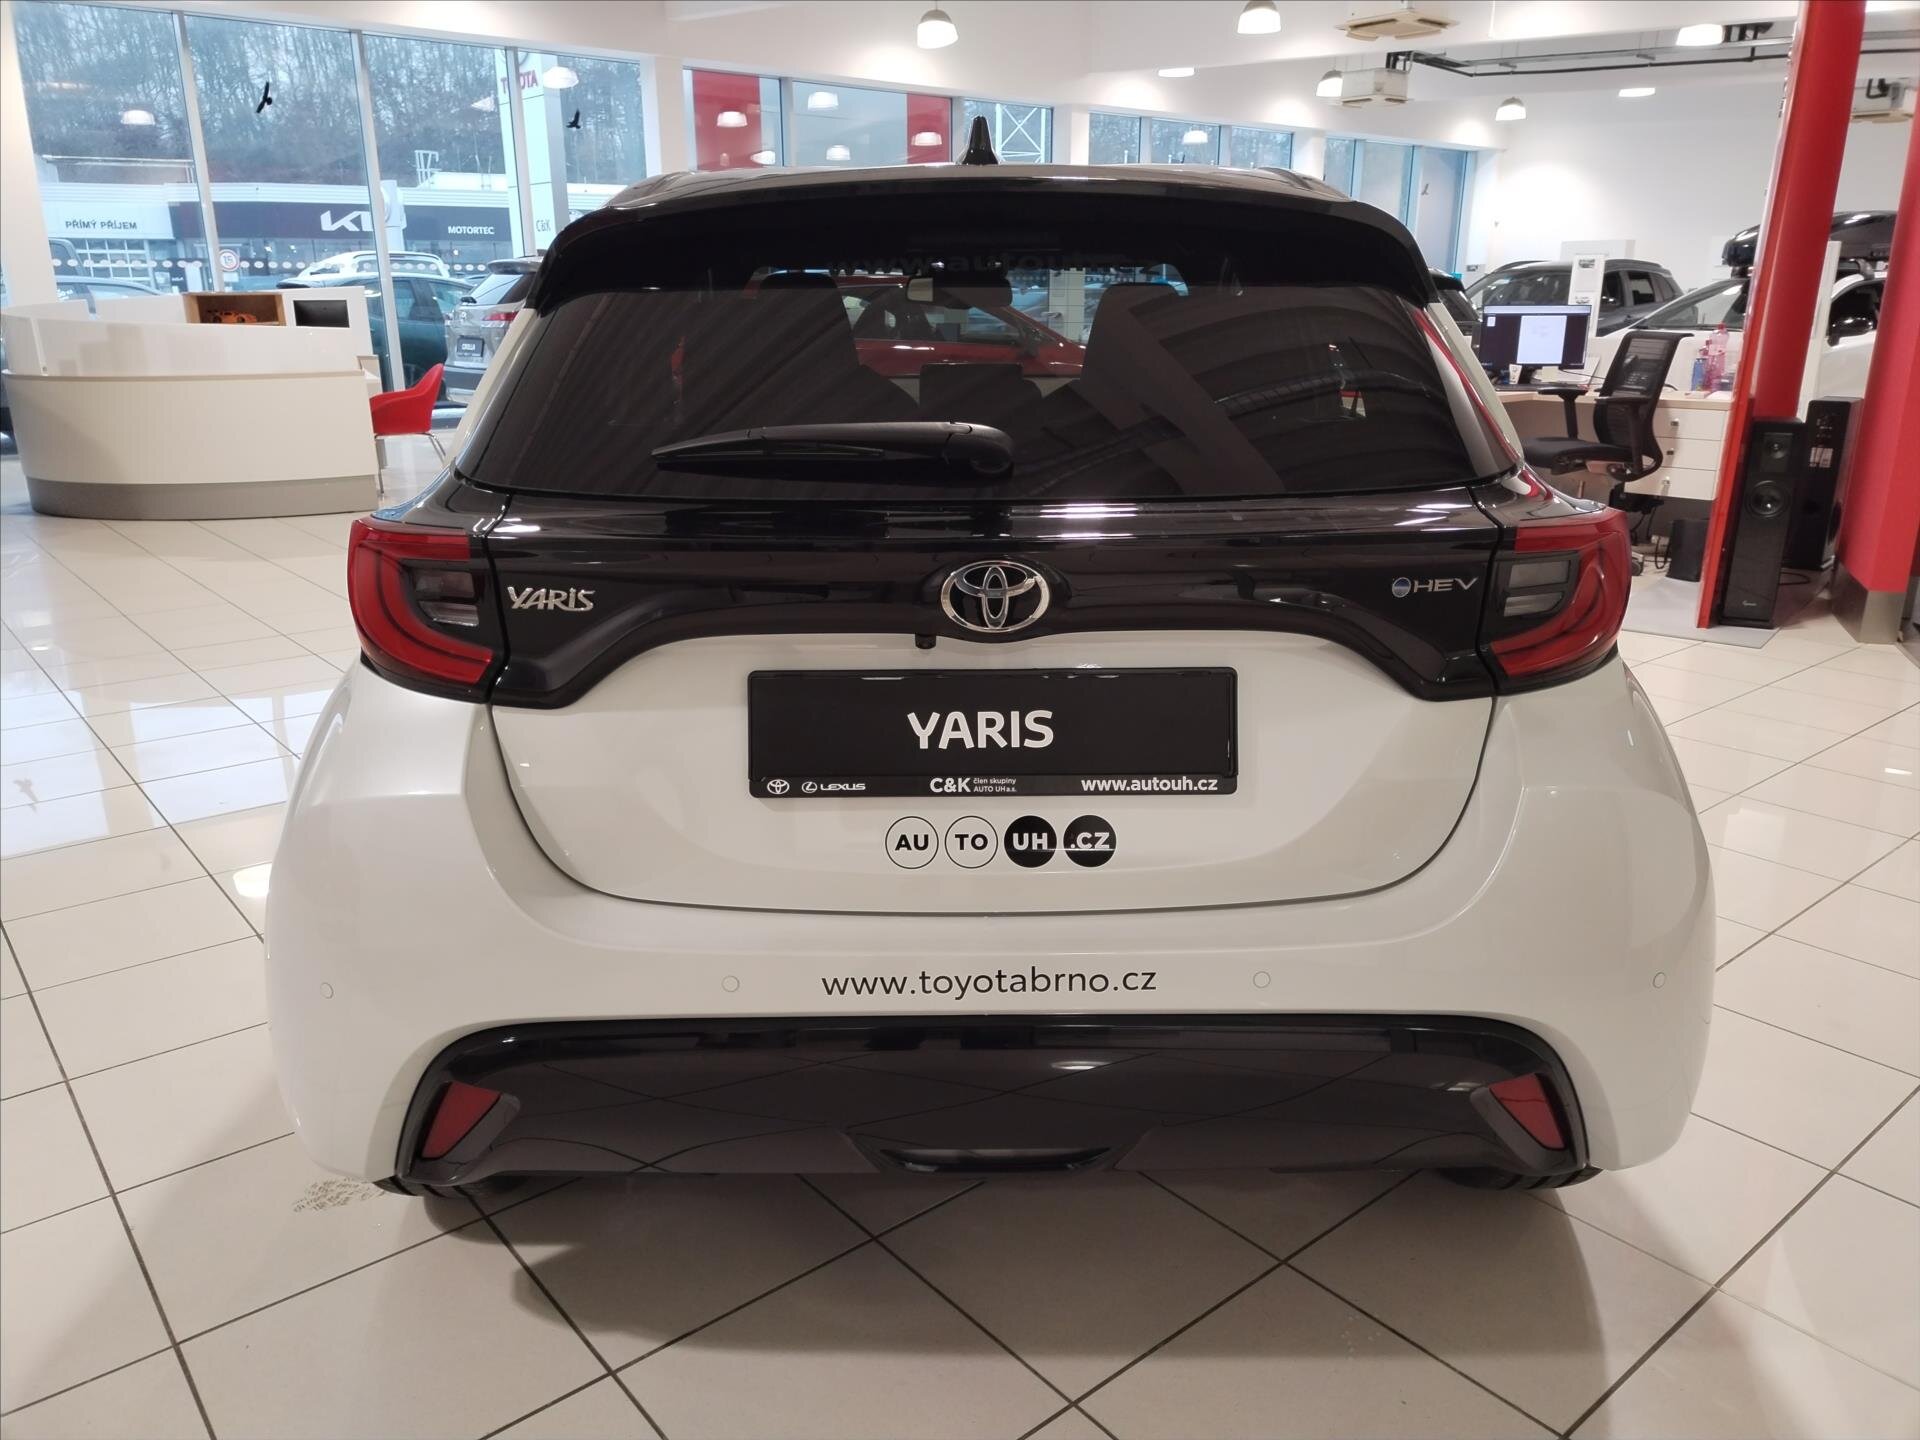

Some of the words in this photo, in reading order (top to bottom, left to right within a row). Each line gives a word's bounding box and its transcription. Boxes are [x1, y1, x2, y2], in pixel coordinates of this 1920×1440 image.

[447, 225, 495, 236] MOTORTEC
[1413, 577, 1478, 593] HEV
[507, 586, 596, 611] YARIS
[907, 709, 1055, 749] YARIS
[820, 783, 866, 791] LEXUS
[929, 777, 972, 793] C&K
[973, 785, 994, 793] AUTO
[990, 777, 1016, 786] skupiny
[1081, 776, 1218, 791] www.autouh.cz
[894, 834, 929, 851] AU
[955, 833, 988, 851] TO
[1012, 832, 1048, 850] UH
[821, 966, 1157, 1000] www.toyotabrno.cz
